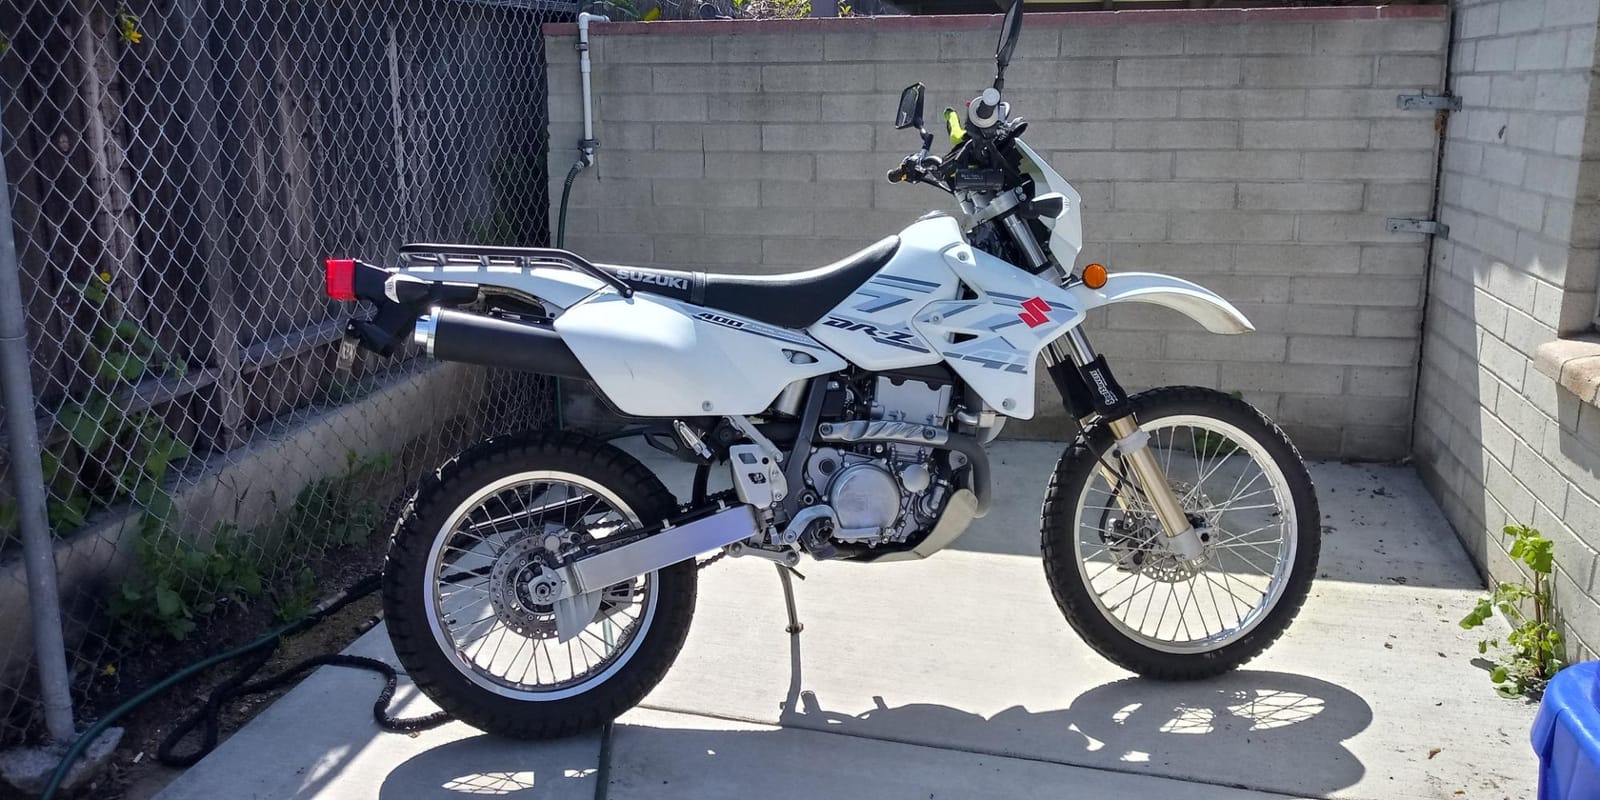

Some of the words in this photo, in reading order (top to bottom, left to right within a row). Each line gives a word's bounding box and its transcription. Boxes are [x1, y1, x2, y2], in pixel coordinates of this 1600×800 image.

[615, 268, 689, 291] SUZUKI
[698, 312, 745, 330] 400
[821, 315, 915, 345] DR-Z
